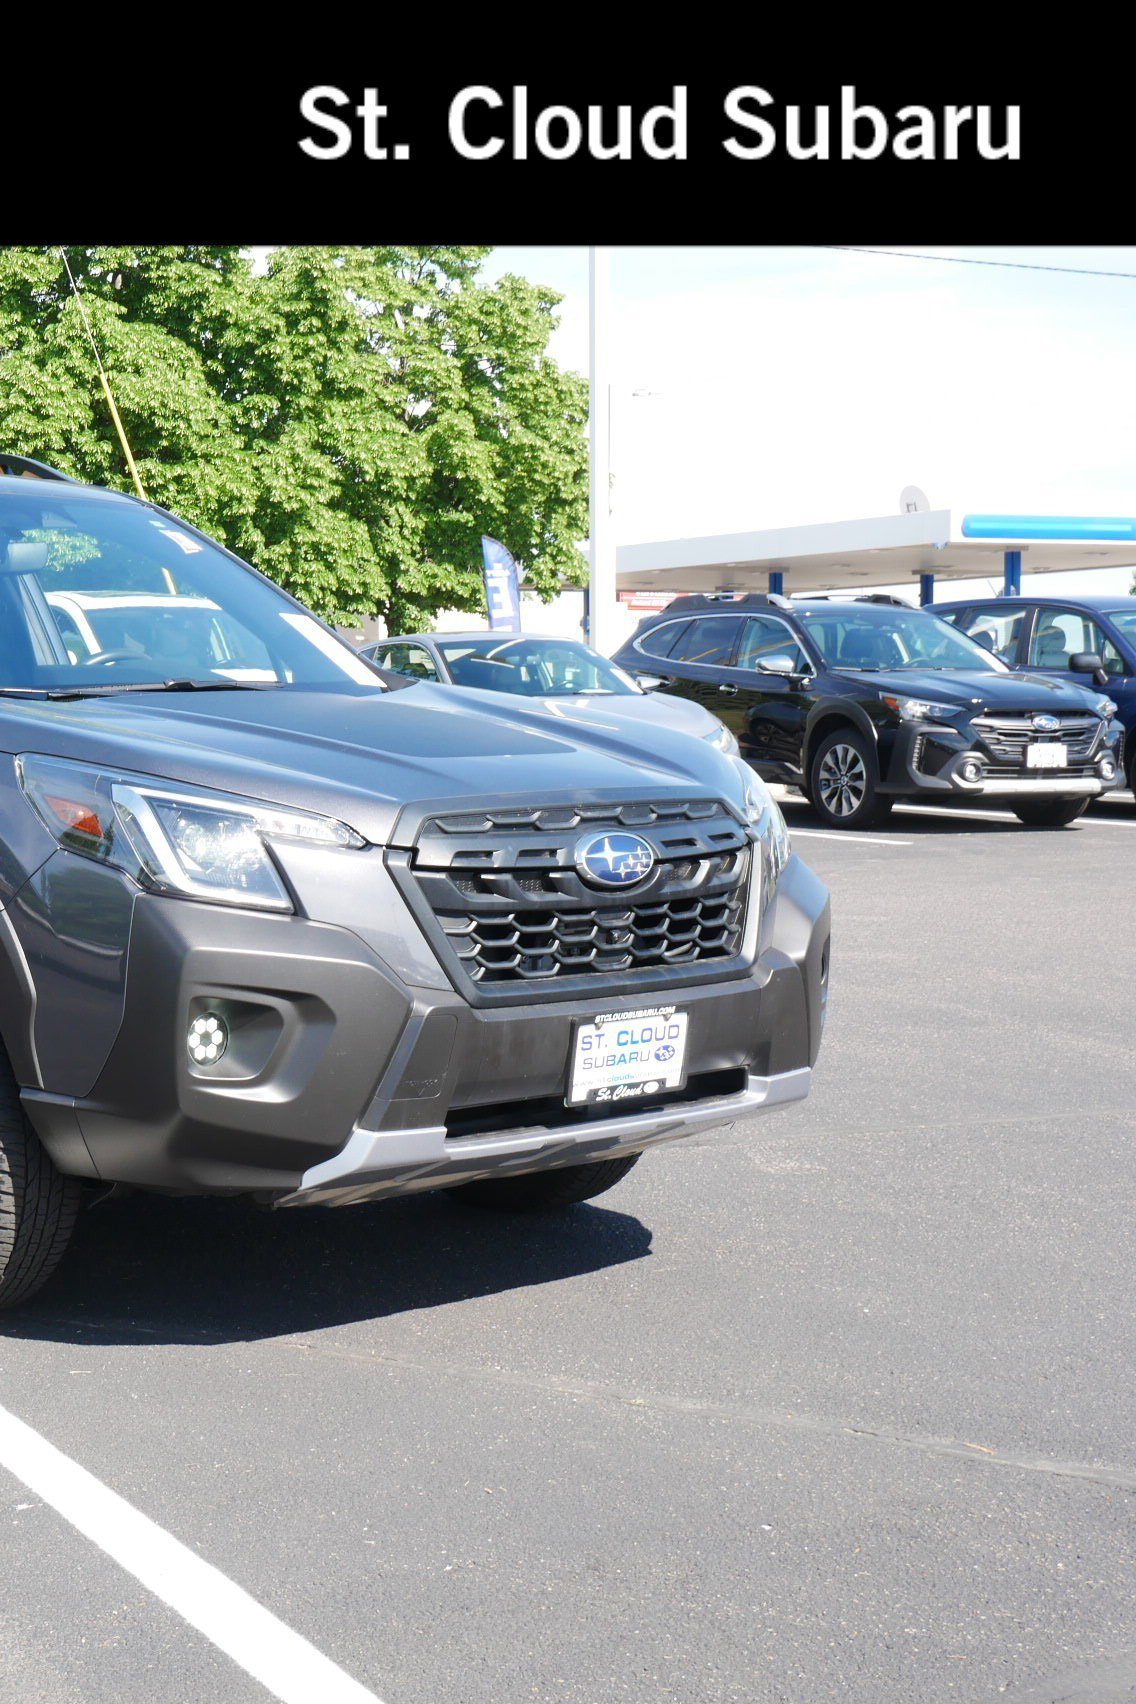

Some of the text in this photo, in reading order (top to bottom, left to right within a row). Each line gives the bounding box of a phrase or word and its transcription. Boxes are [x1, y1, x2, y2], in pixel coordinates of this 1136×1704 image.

[581, 1024, 680, 1051] ST. CLOUD
[582, 1049, 651, 1070] SUBARU
[612, 1083, 644, 1101] Cloud
